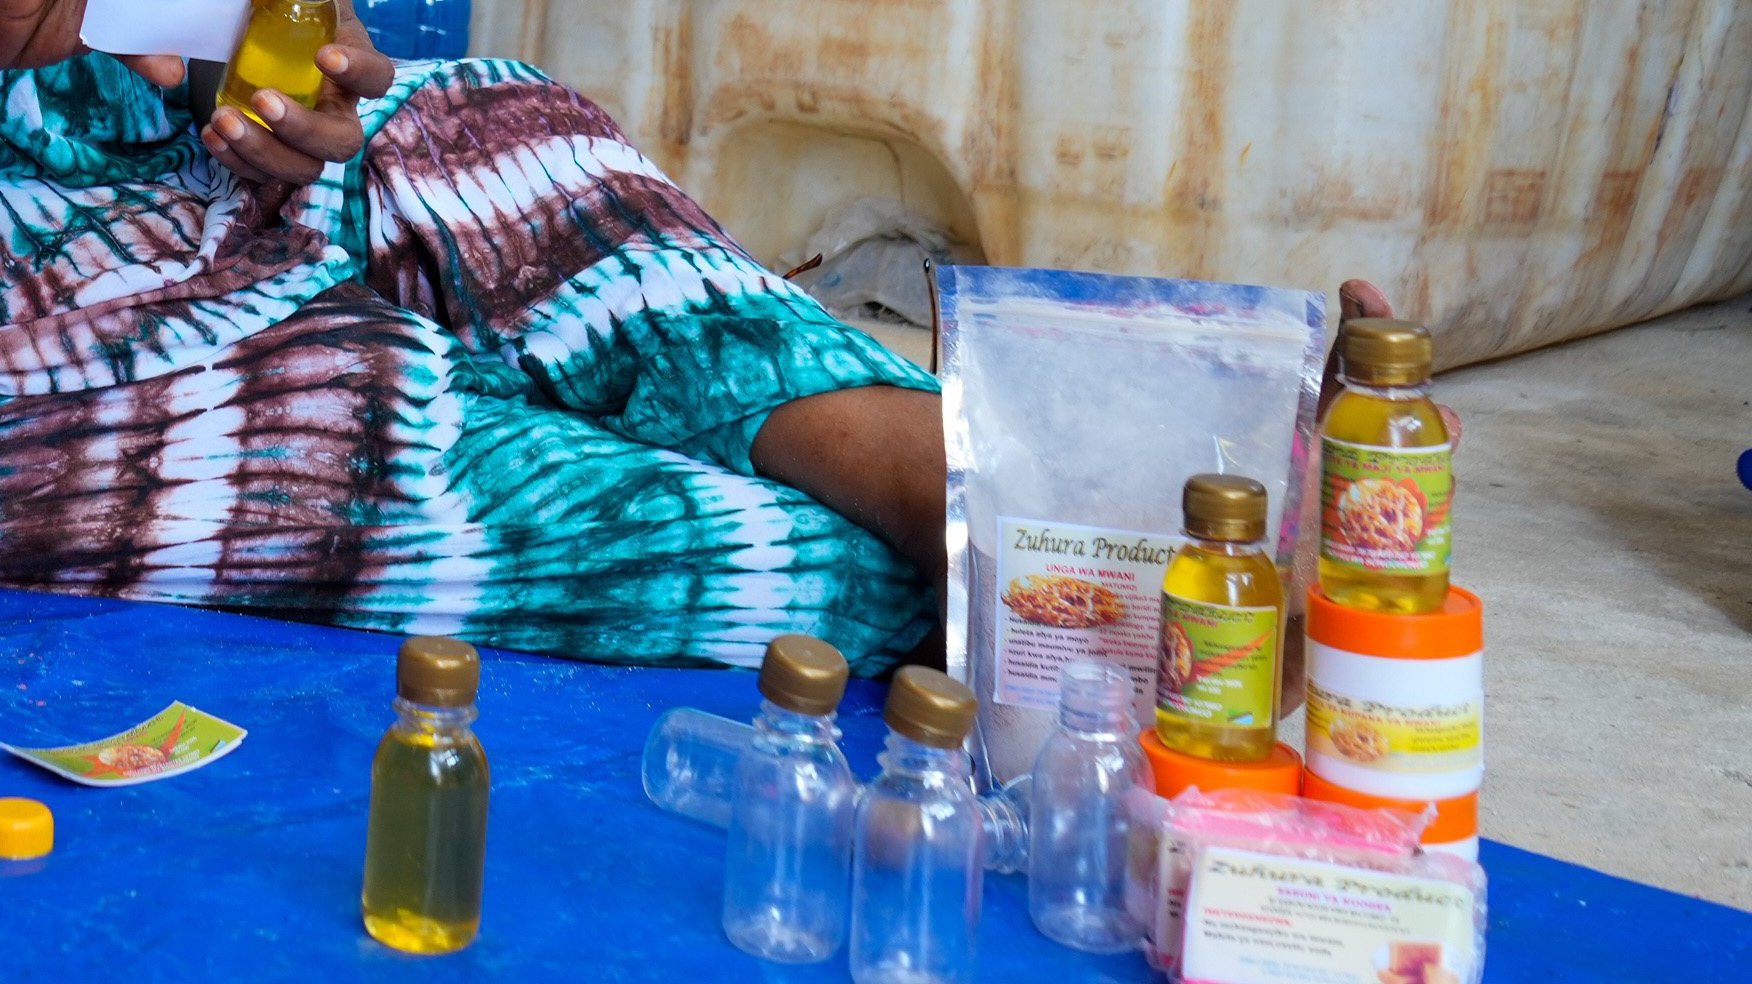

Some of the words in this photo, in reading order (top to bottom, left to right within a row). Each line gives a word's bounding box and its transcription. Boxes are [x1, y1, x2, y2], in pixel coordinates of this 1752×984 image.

[1014, 528, 1087, 558] Zuhura
[1091, 536, 1177, 567] Product
[1045, 563, 1078, 576] UNGA
[1079, 566, 1096, 578] WA
[1097, 568, 1137, 582] MWANI
[1181, 612, 1219, 628] MWANI
[1035, 630, 1053, 640] afya
[1054, 634, 1065, 642] ya
[1066, 635, 1090, 645] moyo
[1027, 650, 1044, 660] kwa
[1037, 642, 1074, 653] maumivu
[1075, 647, 1086, 656] ya
[1008, 659, 1039, 671] husaidia
[1008, 669, 1039, 681] husaidia
[1361, 699, 1470, 719] Product
[1387, 716, 1402, 726] YA
[1207, 859, 1325, 889] Zuhura
[1335, 877, 1465, 910] Product
